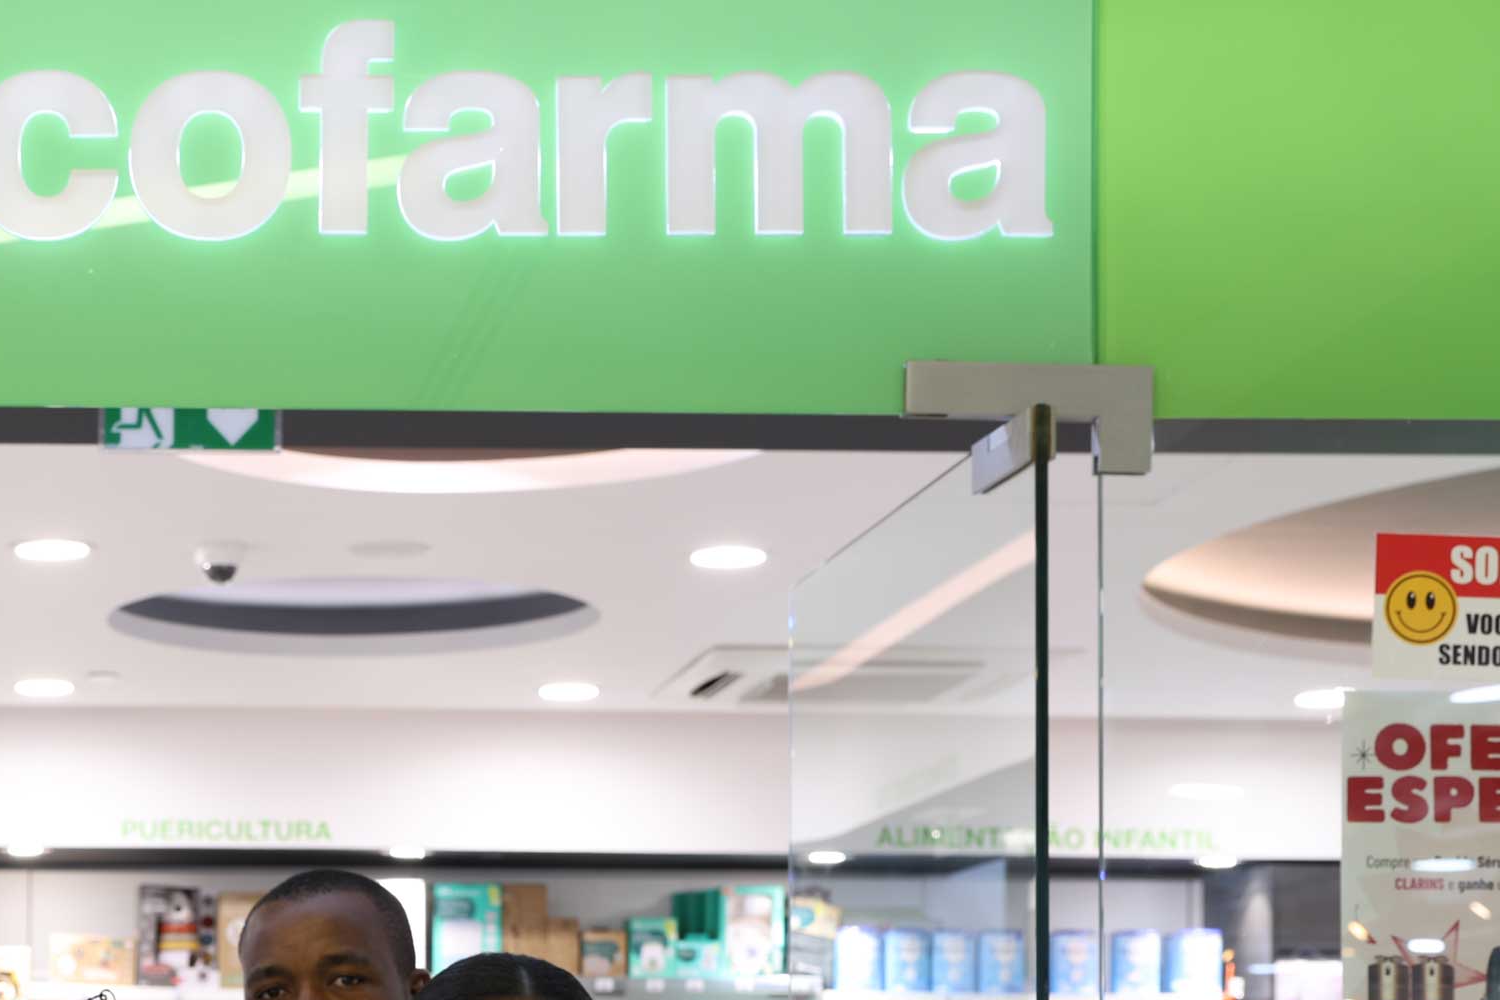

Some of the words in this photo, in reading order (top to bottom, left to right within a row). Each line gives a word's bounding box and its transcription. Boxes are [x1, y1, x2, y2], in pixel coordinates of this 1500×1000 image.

[1438, 643, 1500, 667] SENDO
[1373, 722, 1500, 771] OFE
[1346, 775, 1500, 824] ESPE
[120, 818, 333, 842] PUERICULTURA
